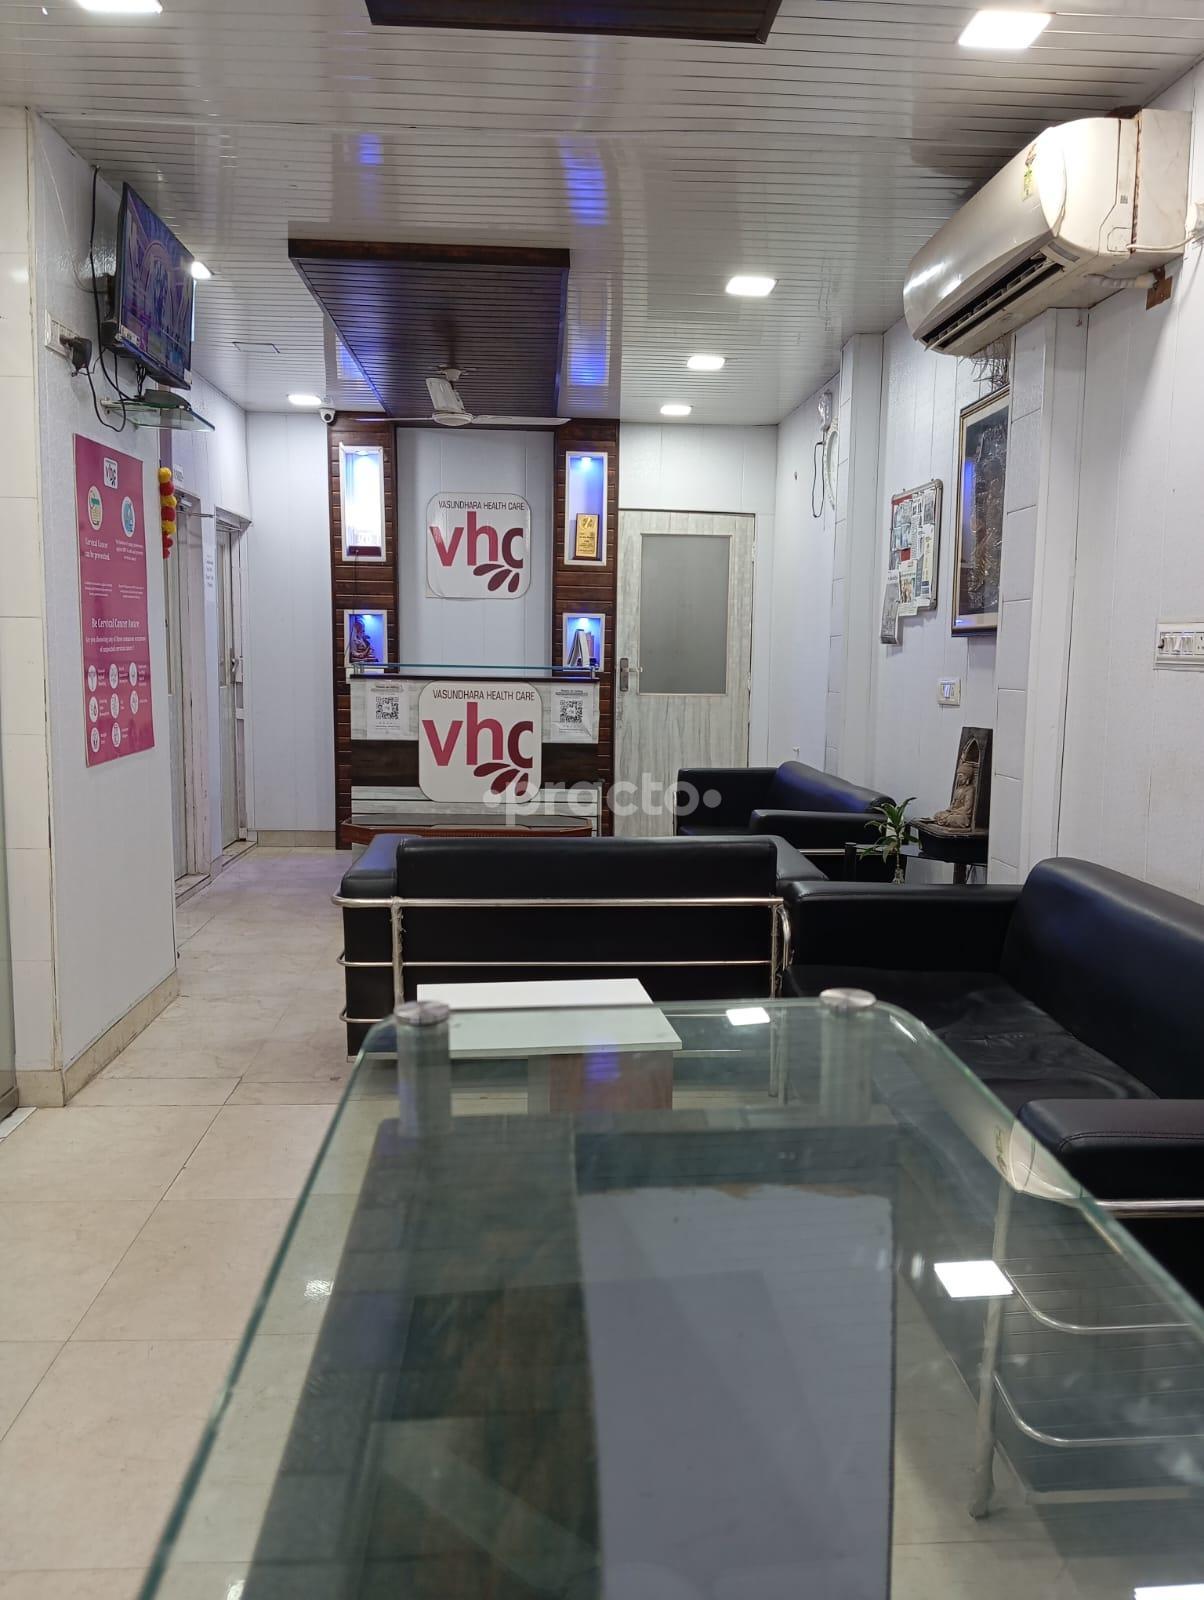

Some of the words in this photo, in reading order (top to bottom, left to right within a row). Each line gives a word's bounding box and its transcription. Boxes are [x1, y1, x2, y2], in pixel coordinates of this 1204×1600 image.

[438, 500, 482, 509] VASUNDHARA
[483, 501, 507, 510] HEALTH
[508, 502, 525, 511] CARE
[429, 511, 524, 569] vhc
[433, 689, 485, 700] VASUNDHARA
[486, 690, 515, 701] HEALTH
[516, 691, 535, 702] CARE
[421, 701, 534, 769] vhc
